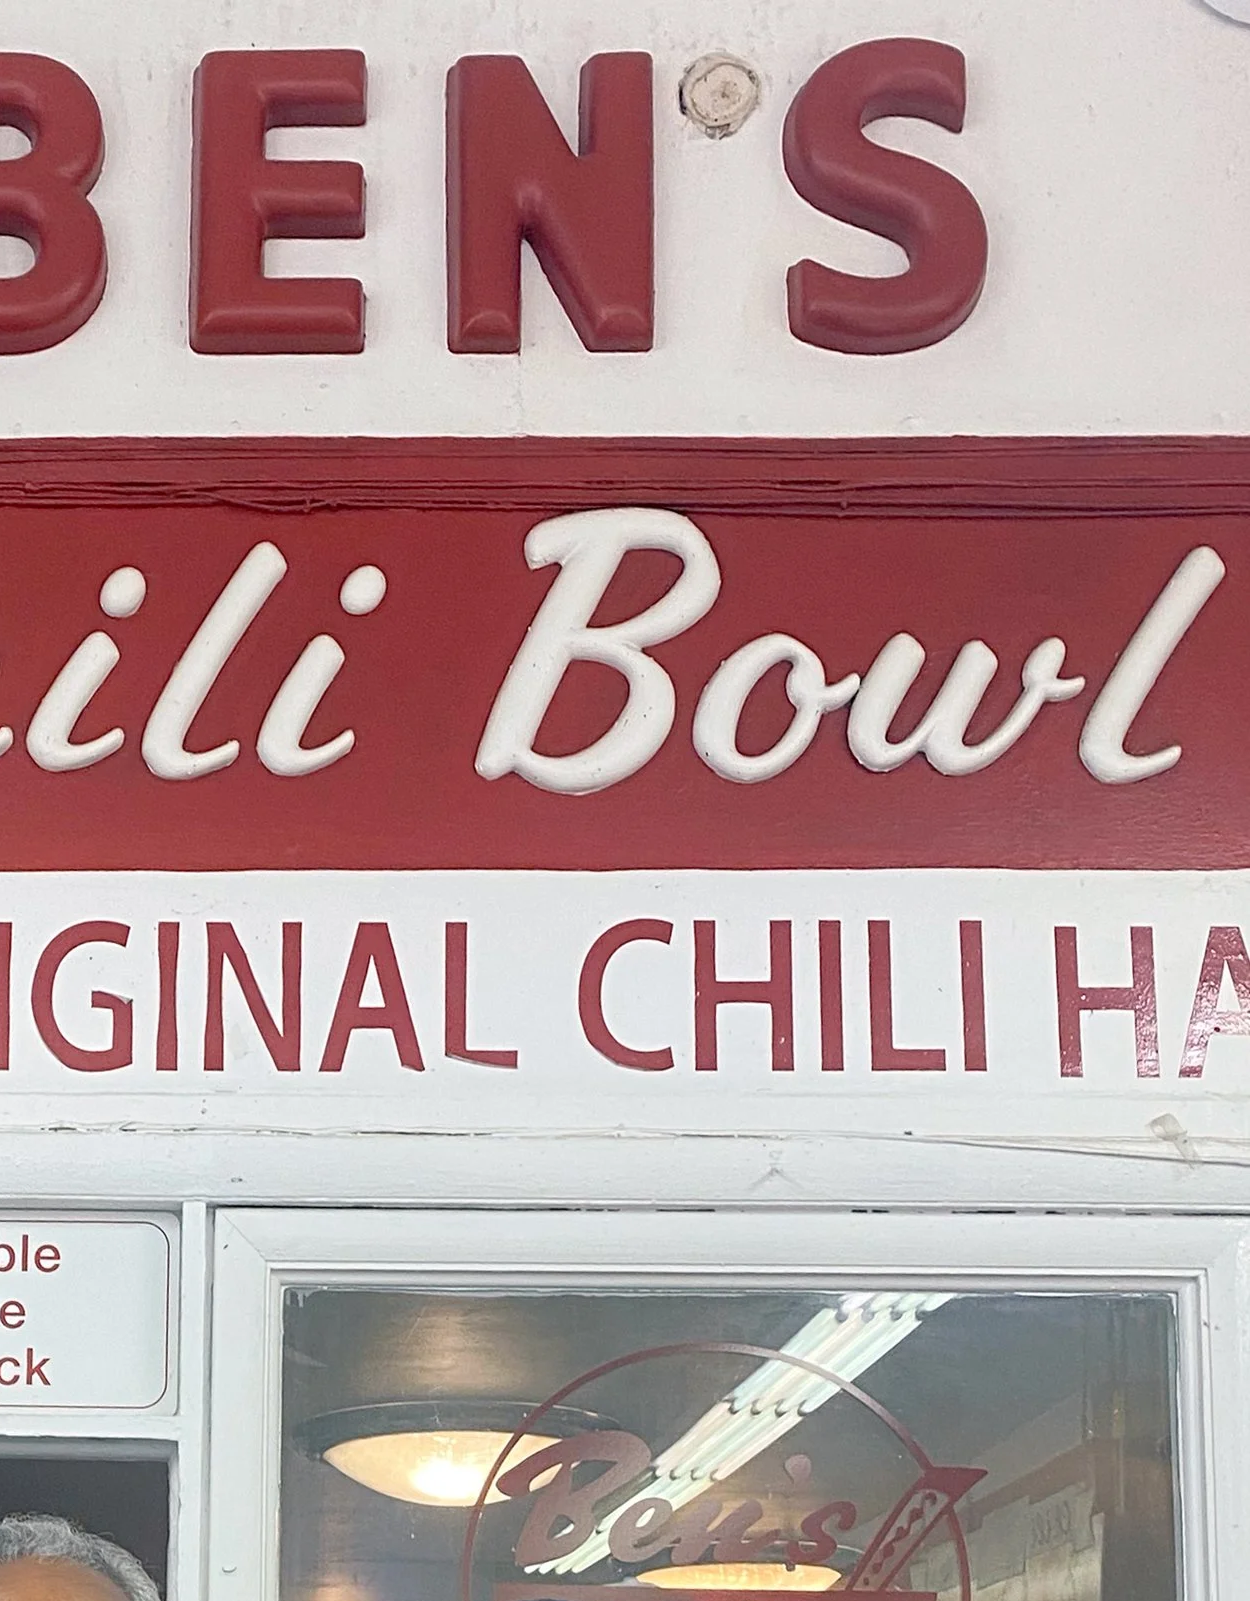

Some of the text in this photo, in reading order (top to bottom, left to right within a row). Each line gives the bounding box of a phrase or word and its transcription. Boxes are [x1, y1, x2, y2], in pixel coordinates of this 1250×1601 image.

[474, 507, 1226, 797] Bowl
[577, 917, 989, 1073] CHILI
[496, 1429, 856, 1565] Ben's
